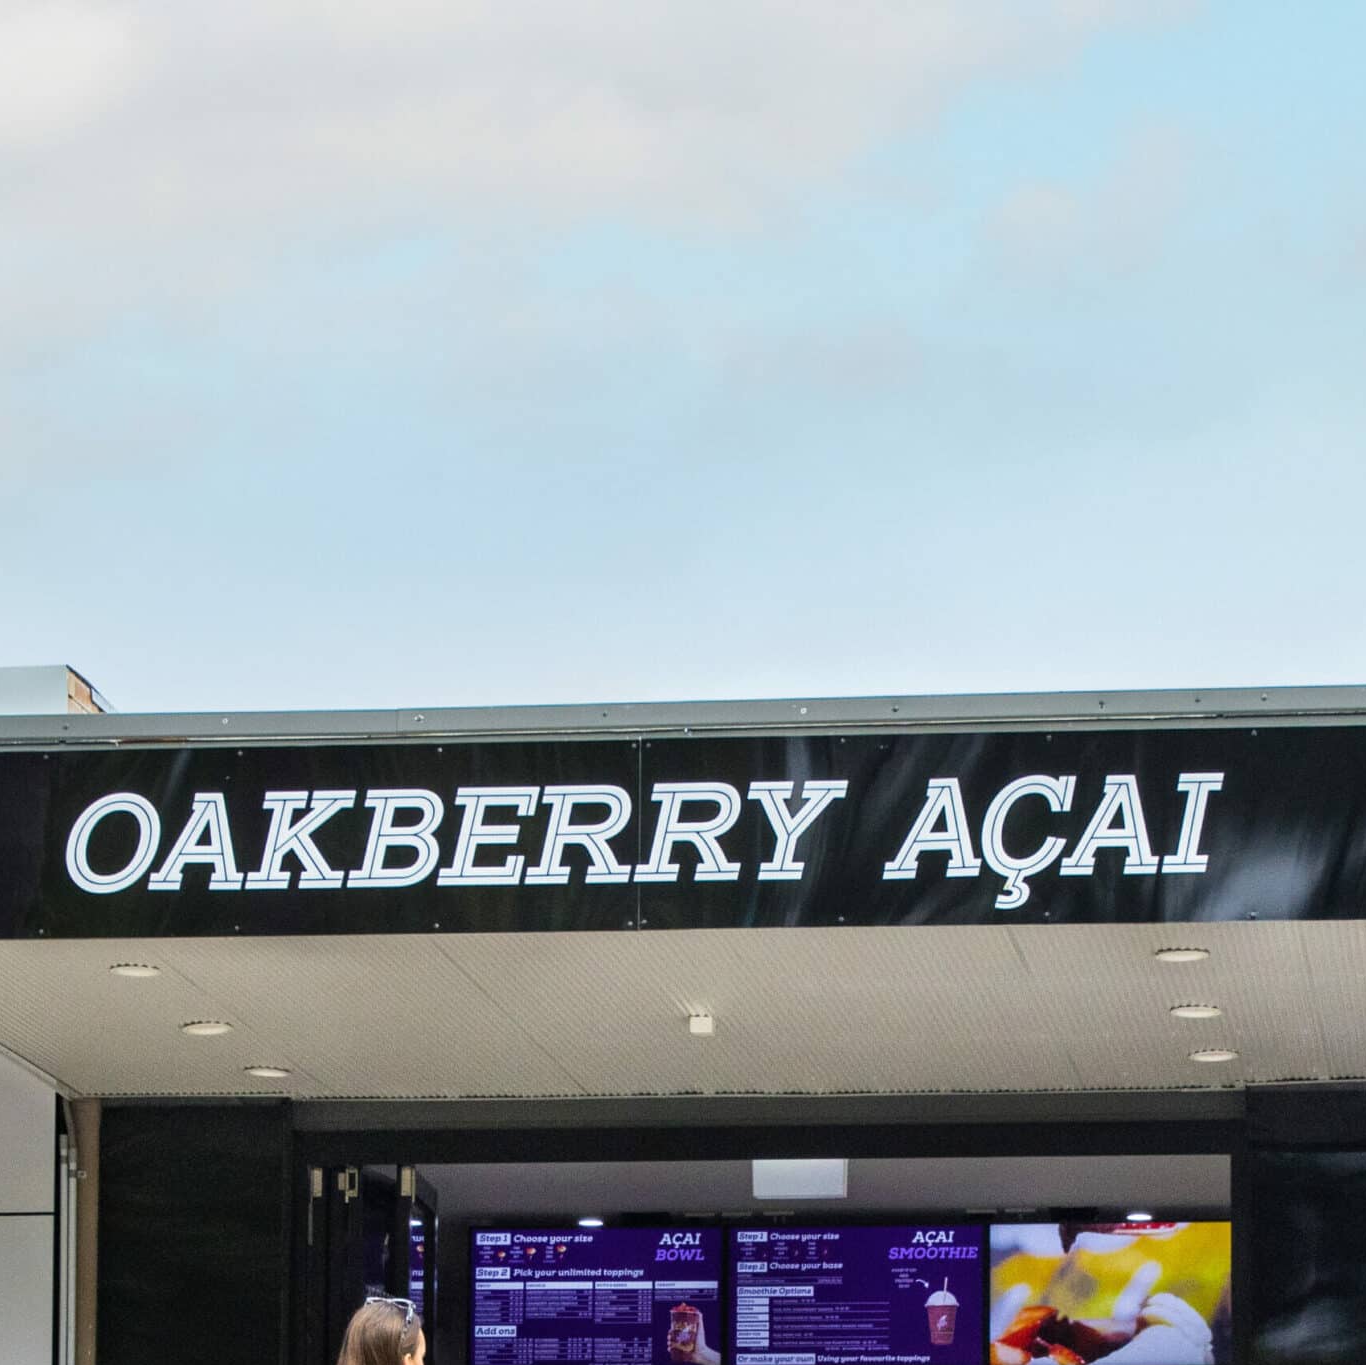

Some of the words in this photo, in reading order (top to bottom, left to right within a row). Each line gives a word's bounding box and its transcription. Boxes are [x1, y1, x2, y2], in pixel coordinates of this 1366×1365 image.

[65, 779, 849, 894] OAKBERRY
[883, 772, 1225, 909] AÇAI
[479, 1234, 500, 1243] Step
[513, 1234, 547, 1243] Choose
[549, 1235, 573, 1245] your
[574, 1234, 594, 1243] size
[659, 1233, 701, 1249] AÇAI
[770, 1232, 800, 1241] Choose
[801, 1233, 822, 1242] your
[822, 1232, 840, 1240] size
[912, 1231, 955, 1247] AÇAI
[655, 1249, 705, 1262] BOWL
[888, 1247, 978, 1260] SMOOTHIE
[769, 1262, 800, 1270] Choose
[801, 1263, 821, 1271] your
[477, 1268, 499, 1277] Step
[513, 1268, 533, 1277] Pick
[534, 1269, 557, 1279] your
[558, 1268, 602, 1277] unlimited
[603, 1268, 644, 1278] toppings
[476, 1327, 497, 1336] Add
[498, 1328, 516, 1336] ons
[838, 1355, 859, 1364] your
